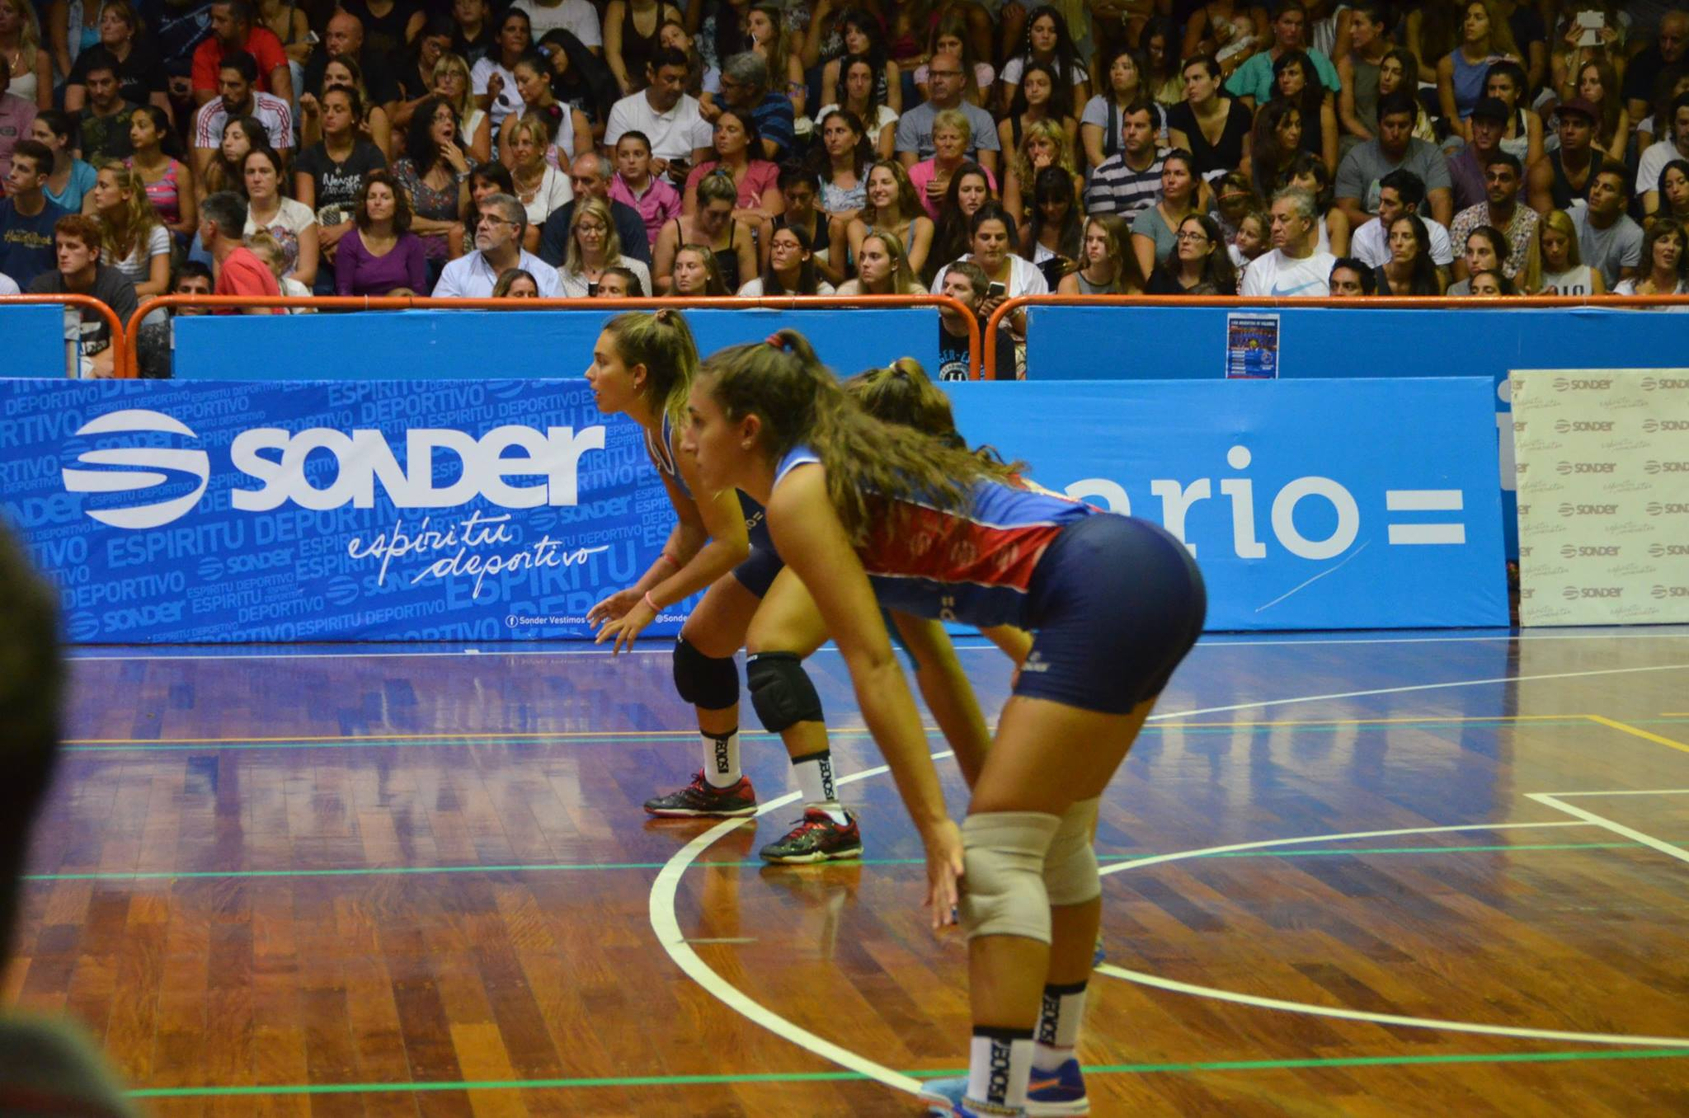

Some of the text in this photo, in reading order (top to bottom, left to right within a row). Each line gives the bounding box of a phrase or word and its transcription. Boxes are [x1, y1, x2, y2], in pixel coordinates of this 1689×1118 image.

[5, 386, 98, 416] DEPORTIVO
[134, 390, 190, 408] DEPORTIVO
[328, 379, 426, 407] ESPIRITU
[361, 384, 485, 424] DEPORTIVO
[162, 396, 249, 421] DEPORTIVO
[427, 403, 494, 428] ESPIRITU
[499, 390, 580, 418] DEPORTIVO
[605, 432, 643, 449] ESPIRIT
[3, 475, 60, 494] DEPORTIVO
[138, 481, 194, 500] DEPORTIVO
[36, 522, 91, 542] DEPORTIVO
[107, 518, 245, 569] ESPIRITU
[578, 524, 642, 546] DEPORTIVO
[411, 535, 609, 600] deportivo
[60, 570, 186, 611] DEPORTIVO
[186, 572, 294, 599] ESPIRITU DEPORTIVO
[192, 588, 262, 615] ESPIRITU
[238, 595, 325, 624] DEPORTIVO
[296, 599, 446, 637] ESPIRITU DEPORTIVO
[519, 616, 548, 625] Sonder
[549, 616, 586, 625] Vestimos
[654, 613, 688, 625] @Sonde
